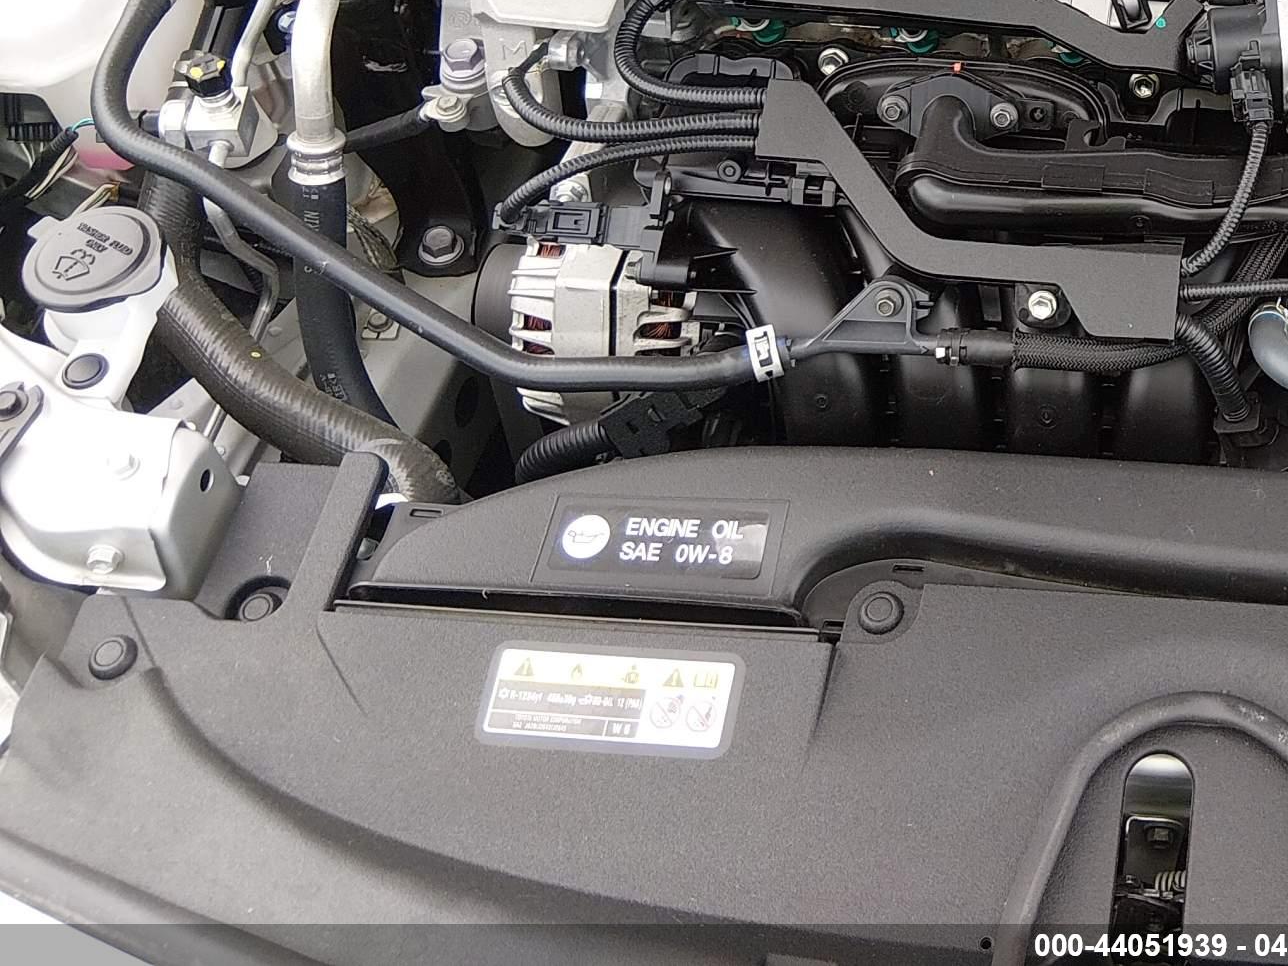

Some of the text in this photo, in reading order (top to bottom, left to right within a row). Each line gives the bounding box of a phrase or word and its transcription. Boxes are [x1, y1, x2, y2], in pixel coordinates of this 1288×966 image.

[625, 517, 744, 539] ENGINE OIL
[619, 541, 734, 565] SAE 0W-8
